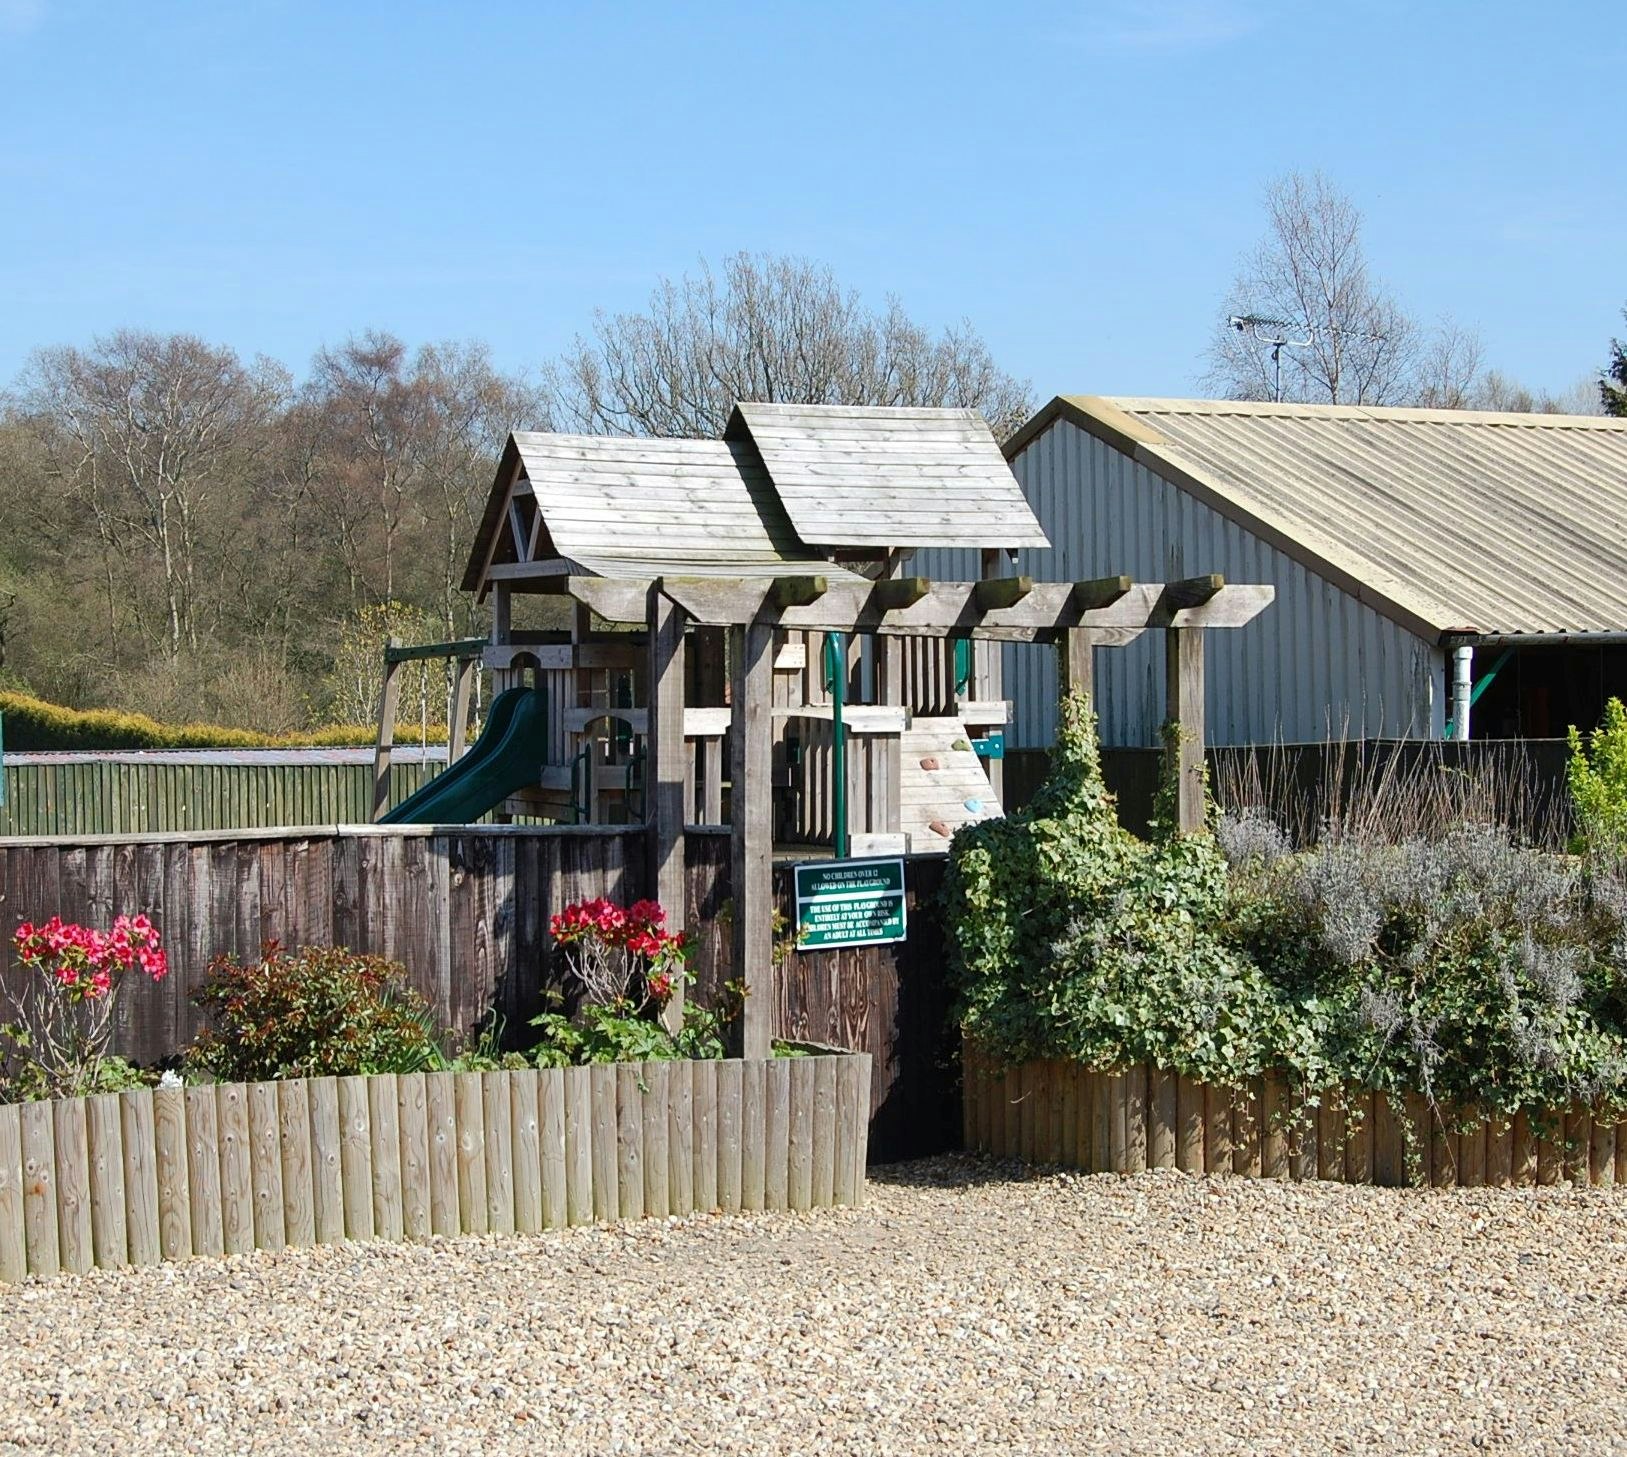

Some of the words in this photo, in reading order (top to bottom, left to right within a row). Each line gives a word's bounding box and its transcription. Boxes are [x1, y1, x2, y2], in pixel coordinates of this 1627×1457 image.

[831, 871, 857, 880] CHILDREN
[857, 878, 890, 888] PLAYGROUND
[854, 901, 887, 910] PLAYGROUND
[815, 913, 840, 922] ENTIRELY
[848, 912, 862, 920] YOUR
[832, 922, 845, 930] MUST
[832, 930, 848, 939] ADULT
[857, 929, 866, 937] ALL
